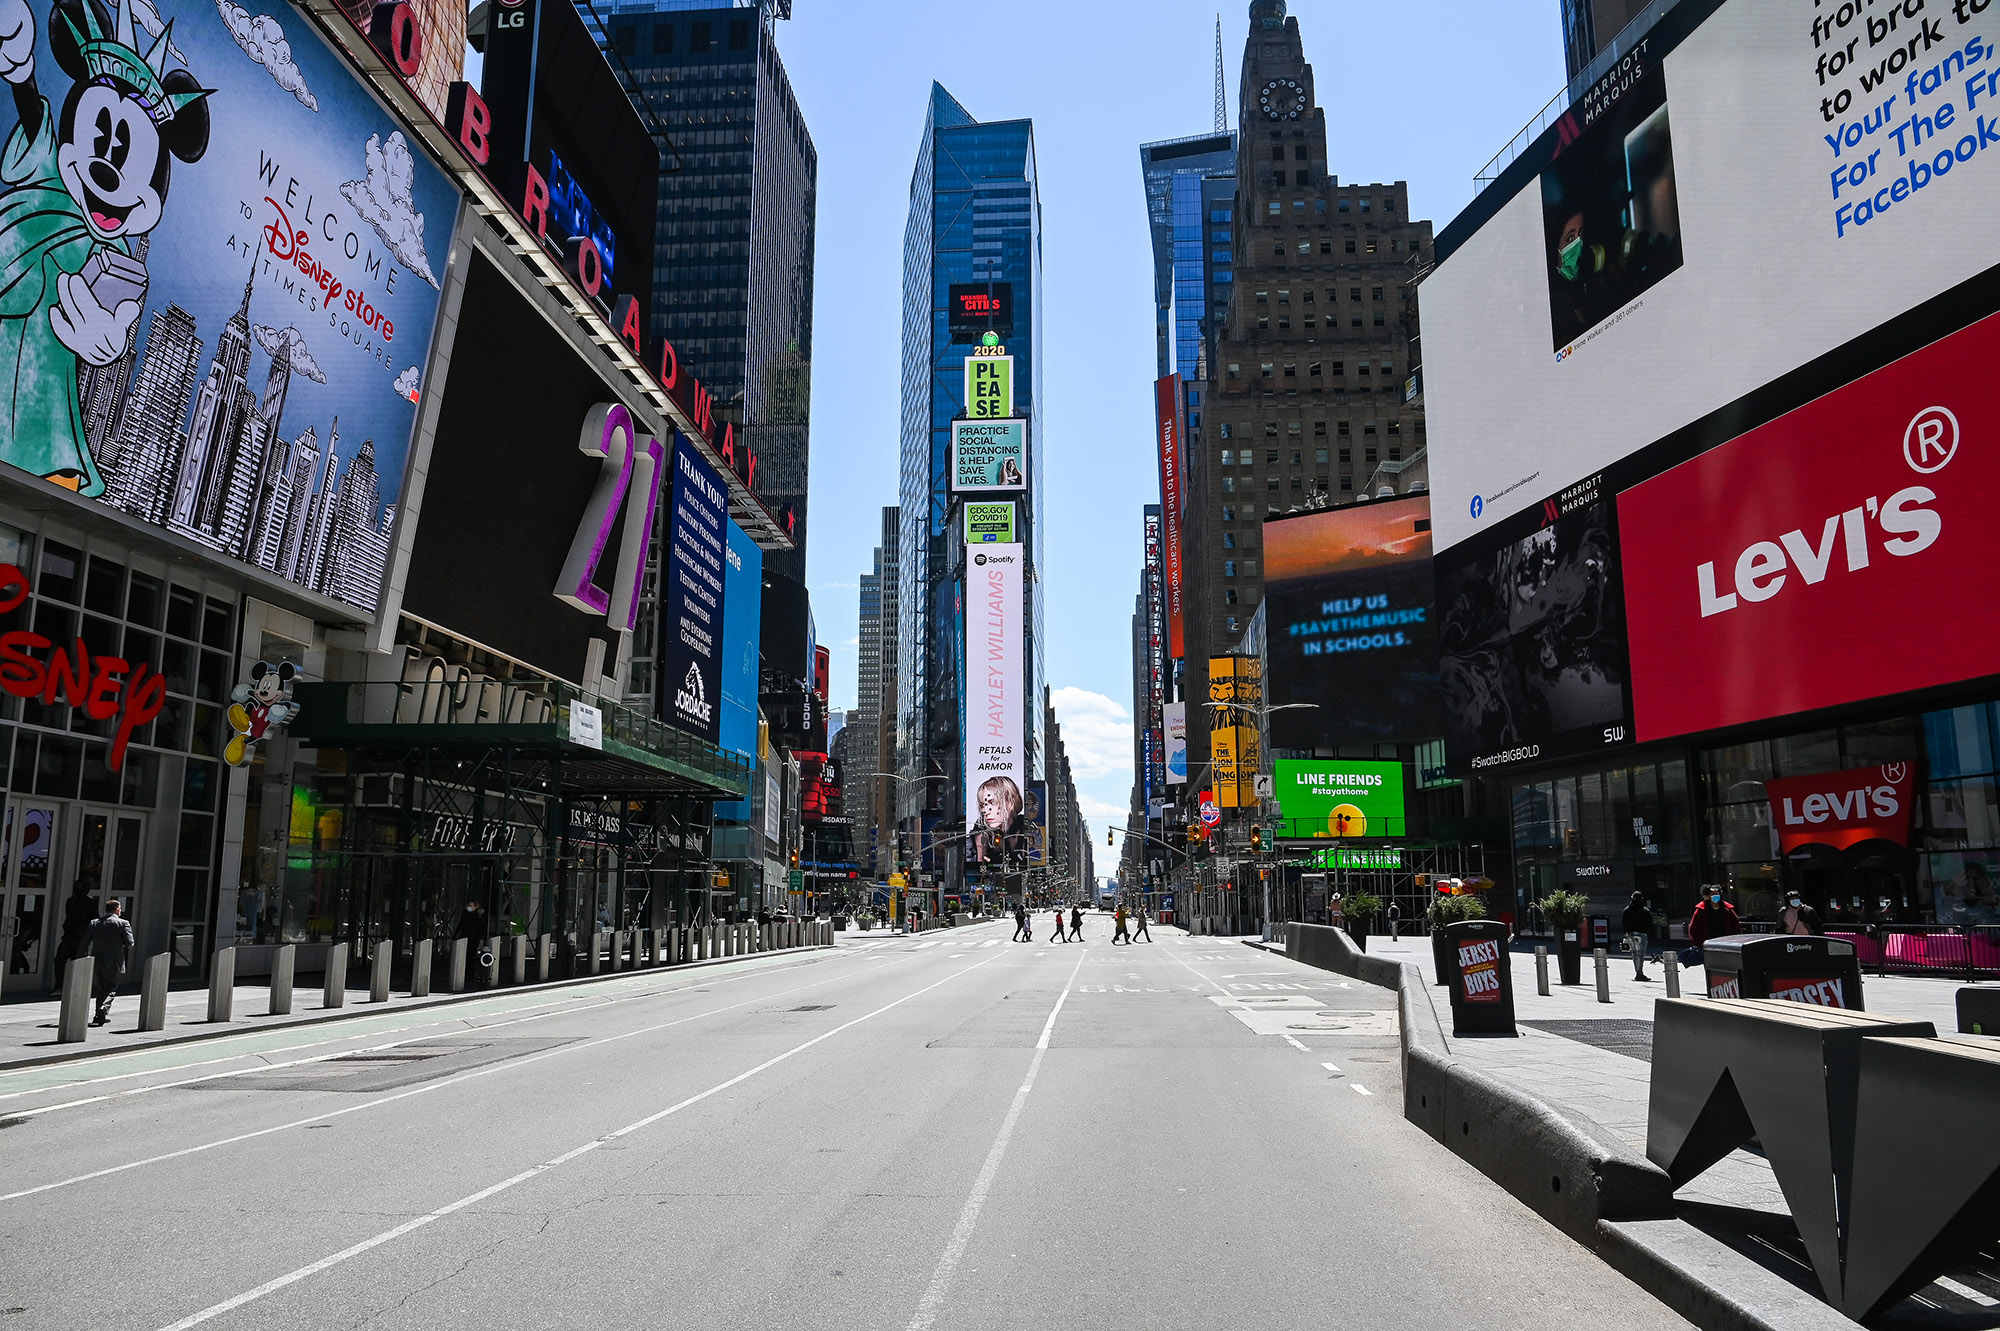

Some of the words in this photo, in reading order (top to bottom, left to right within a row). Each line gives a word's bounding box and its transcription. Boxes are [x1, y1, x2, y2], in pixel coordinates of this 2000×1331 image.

[497, 11, 525, 29] LG
[1584, 38, 1648, 109] MARRIOTT
[1815, 36, 1859, 87] for
[1820, 88, 1852, 123] to
[1859, 16, 1946, 94] work
[1585, 64, 1642, 125] MARQUIS
[1824, 94, 1896, 158] Your
[1904, 35, 1994, 106] fans,
[1830, 148, 1881, 200] For
[1888, 103, 1955, 157] The
[1835, 115, 2000, 239] Facebook
[259, 149, 398, 295] WELCOME
[239, 200, 253, 219] TO
[344, 289, 394, 342] store
[458, 82, 758, 488] BROADWAY
[227, 234, 250, 259] AT
[263, 259, 317, 312] TIMES
[329, 312, 392, 371] SQUARE
[1587, 326, 1603, 341] Walker
[1604, 318, 1614, 330] and
[1626, 300, 1644, 316] others
[974, 345, 1005, 356] 2020
[976, 362, 1000, 379] PL
[976, 381, 1001, 397] EA
[976, 399, 1000, 416] SE
[959, 426, 1010, 436] PRACTICE
[959, 436, 996, 446] SOCIAL
[1163, 419, 1172, 454] Thank
[959, 445, 1020, 456] DISTANCING
[959, 457, 966, 465] &
[968, 456, 995, 465] HELP
[959, 466, 985, 475] SAVE
[959, 476, 989, 485] LIVES.
[1164, 456, 1173, 477] you
[679, 451, 706, 494] THANK
[706, 481, 725, 513] YOU!
[1166, 478, 1174, 490] to
[1561, 474, 1602, 502] MARRIOTT
[684, 486, 699, 512] POLICE
[700, 503, 718, 530] OFFICERS
[1166, 491, 1175, 510] the
[1562, 489, 1599, 514] MARQUIS
[555, 403, 664, 631] 21
[678, 503, 699, 532] MILITARY
[699, 522, 721, 553] PERSONNEL
[678, 525, 700, 554] DOCTORS
[700, 548, 704, 558] &
[704, 549, 720, 572] NURSES
[1167, 511, 1178, 569] healthcare
[674, 543, 702, 577] HEALTHCARE
[703, 568, 722, 593] WORKERS
[988, 556, 1015, 564] Spotify
[679, 569, 698, 594] TESTING
[698, 584, 716, 608] CENTERS
[1171, 570, 1180, 616] workers.
[683, 594, 711, 625] VOLUNTEERS
[989, 570, 1004, 661] WILLIAMS
[1322, 597, 1362, 615] HELP
[1365, 594, 1388, 610] US
[680, 616, 691, 631] AND
[691, 620, 712, 646] EVERYONE
[1289, 607, 1427, 637] #SAVETHEMUSIC
[680, 629, 711, 658] COOPERATING
[1303, 641, 1322, 656] IN
[1325, 632, 1412, 654] SCHOOLS.
[675, 688, 712, 722] JORDACHE
[802, 694, 811, 730] 1500
[989, 665, 1004, 738] HAYLEY
[676, 711, 709, 731] ENTERPRISES
[979, 746, 1013, 755] PETALS
[1214, 758, 1233, 768] LION
[1472, 744, 1540, 769] #SwatchBIGBOLD
[977, 763, 1013, 771] ARMOR
[1213, 769, 1236, 782] KING
[1296, 773, 1326, 785] LINE
[1329, 774, 1383, 786] FRIENDS
[1312, 787, 1369, 796] #stayathome
[1632, 817, 1643, 827] NO
[1633, 825, 1653, 836] TIME
[1639, 835, 1650, 845] TO
[1458, 939, 1500, 968] JERSEY
[1464, 968, 1500, 996] BOYS
